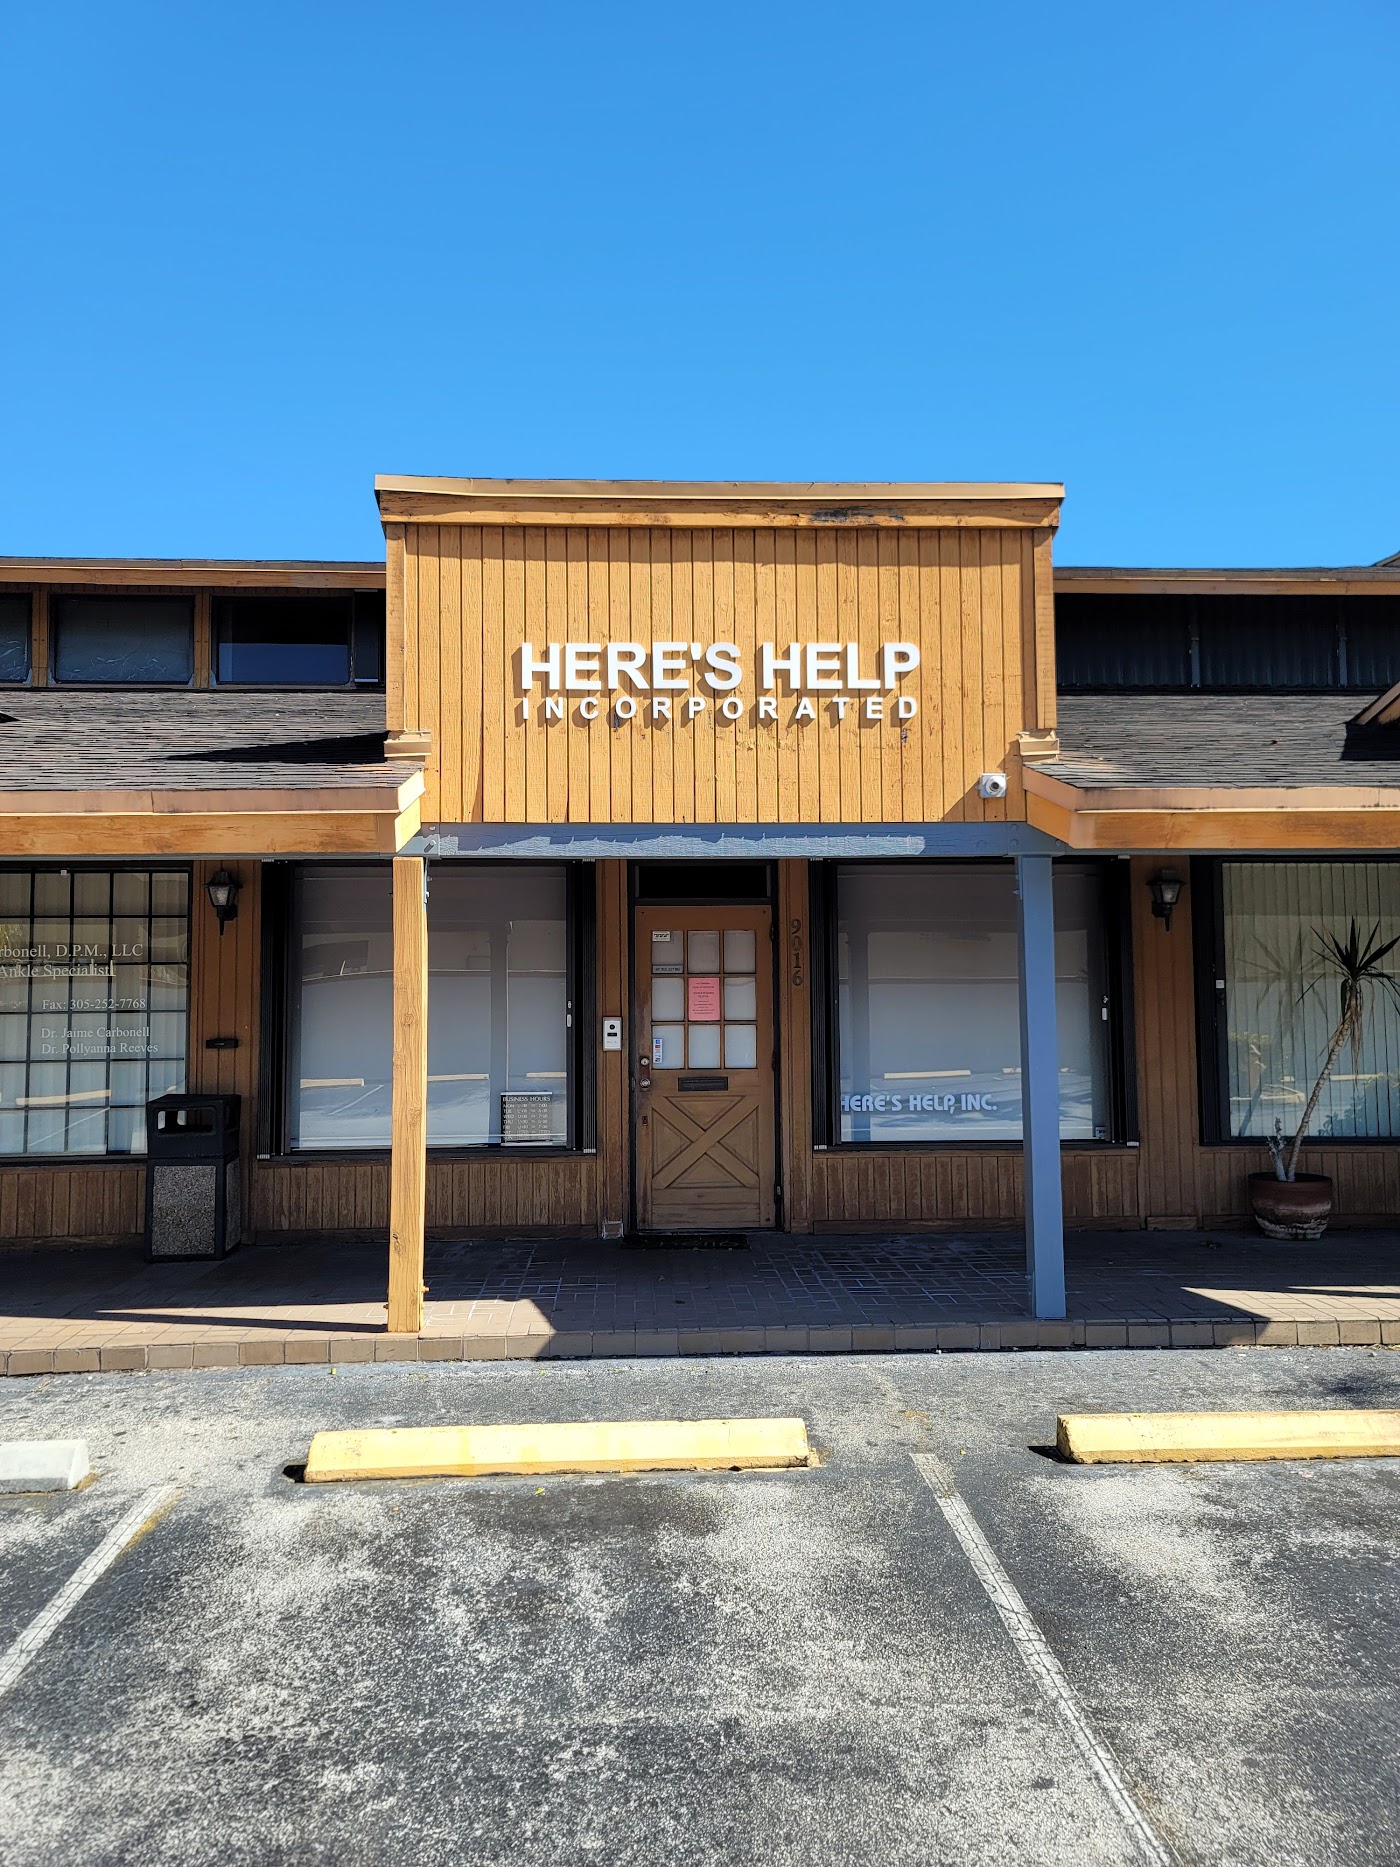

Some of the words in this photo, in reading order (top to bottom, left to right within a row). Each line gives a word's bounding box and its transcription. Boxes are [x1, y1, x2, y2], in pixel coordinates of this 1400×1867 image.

[520, 641, 743, 690] HERE'S
[762, 641, 921, 690] HELP
[521, 697, 919, 720] INCORPORATED
[56, 944, 107, 959] D.P.M.,
[112, 943, 144, 957] LLC
[0, 964, 39, 978] Ankle
[43, 963, 110, 980] Specialist
[42, 999, 66, 1010] Fax:
[70, 998, 146, 1009] 305-252-7768
[41, 1028, 58, 1039] Dr.
[61, 1028, 93, 1038] Jaime
[96, 1027, 150, 1038] Carbonell
[41, 1044, 58, 1054] Dr.
[62, 1044, 116, 1056] Pollyanna
[119, 1042, 159, 1053] Reeves
[841, 1095, 903, 1112] HERE'S
[909, 1095, 956, 1114] HELP,
[961, 1094, 998, 1111] INC.
